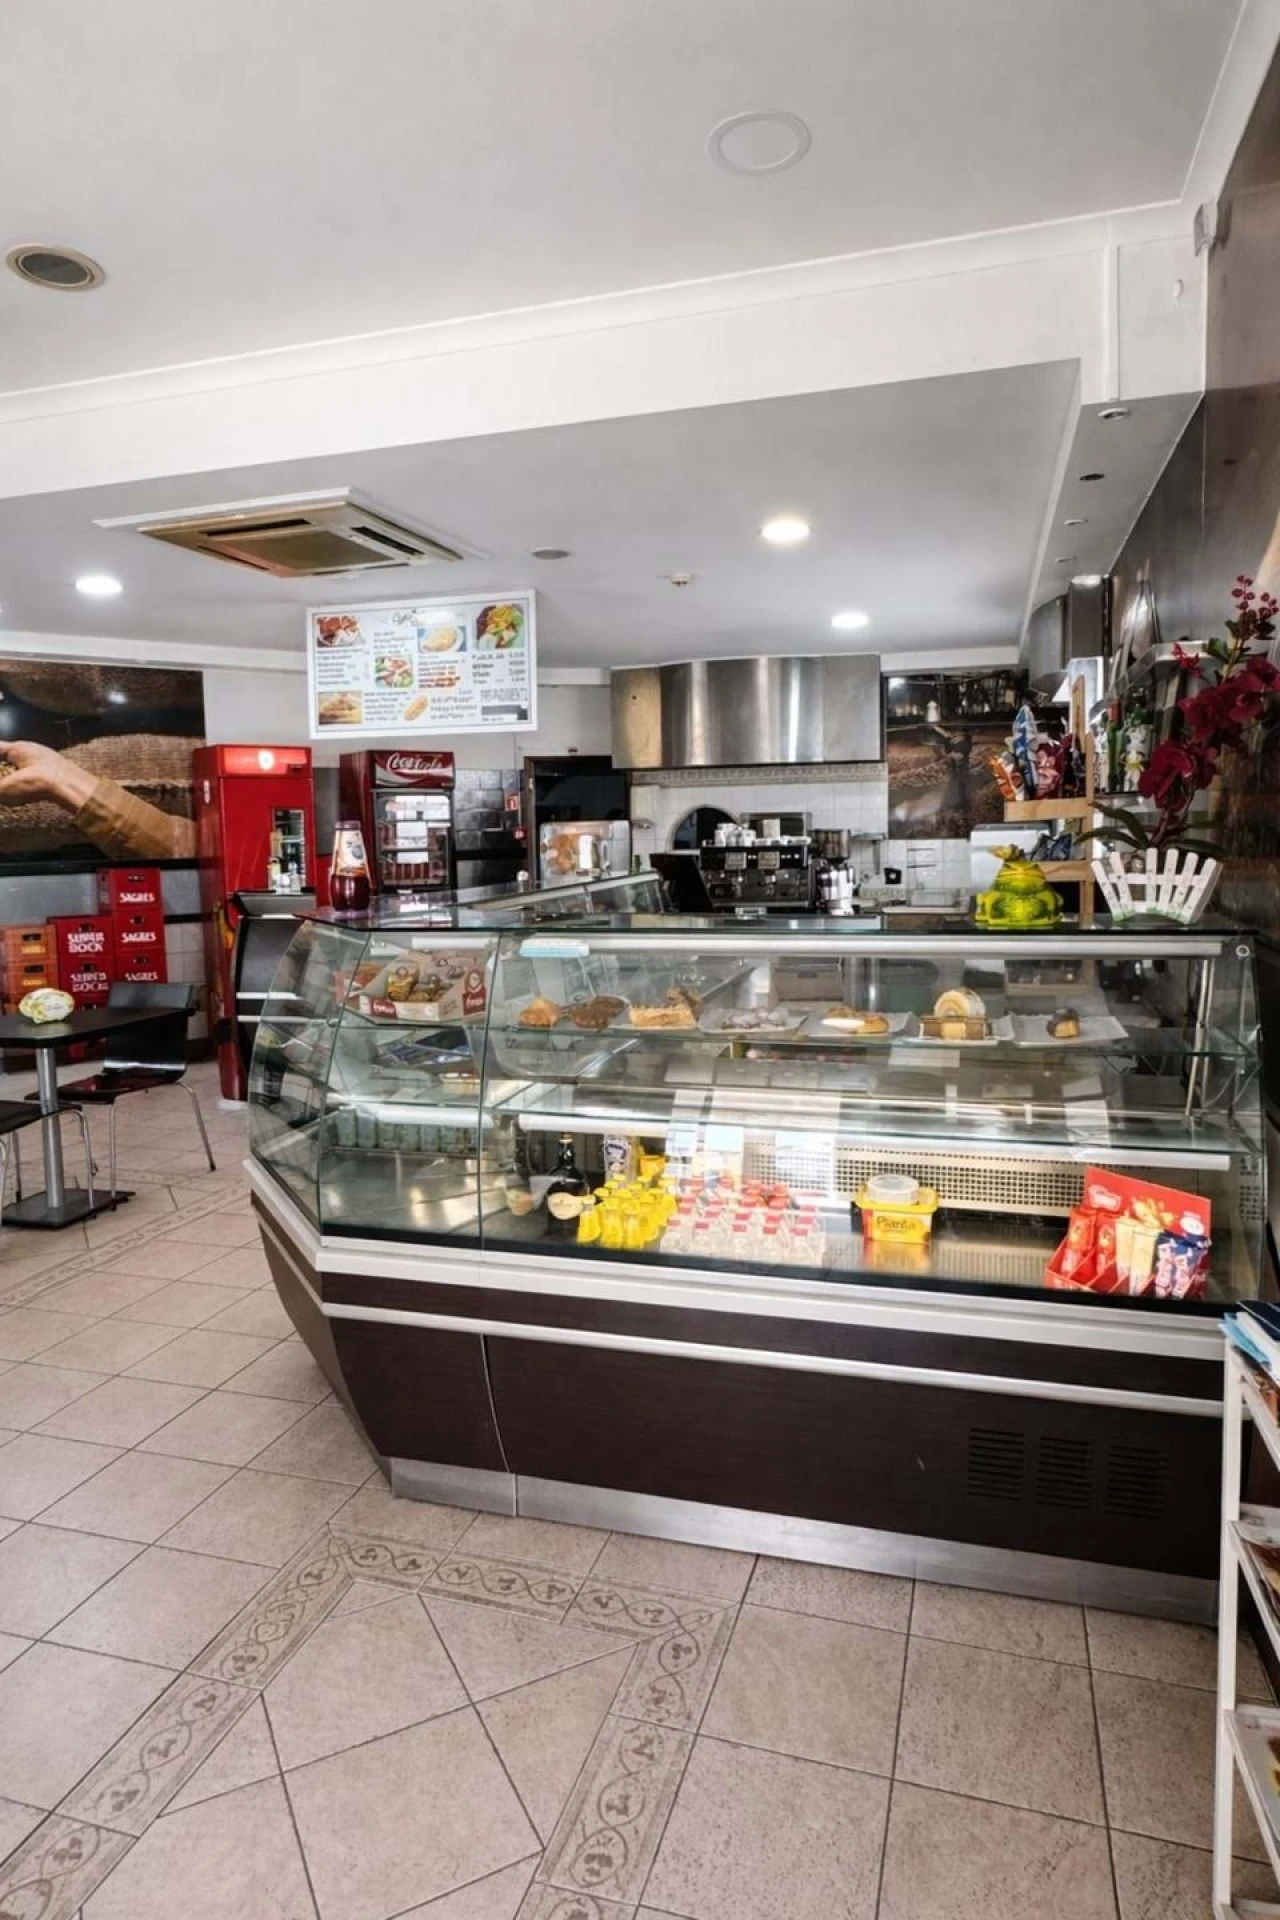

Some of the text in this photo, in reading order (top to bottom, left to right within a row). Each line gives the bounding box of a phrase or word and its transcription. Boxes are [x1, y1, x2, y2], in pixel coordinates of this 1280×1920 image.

[120, 892, 155, 903] SAGRES
[67, 932, 104, 942] SUPER
[121, 932, 156, 943] SAGRES
[68, 942, 103, 953] BOCK
[876, 1215, 917, 1229] Planta
